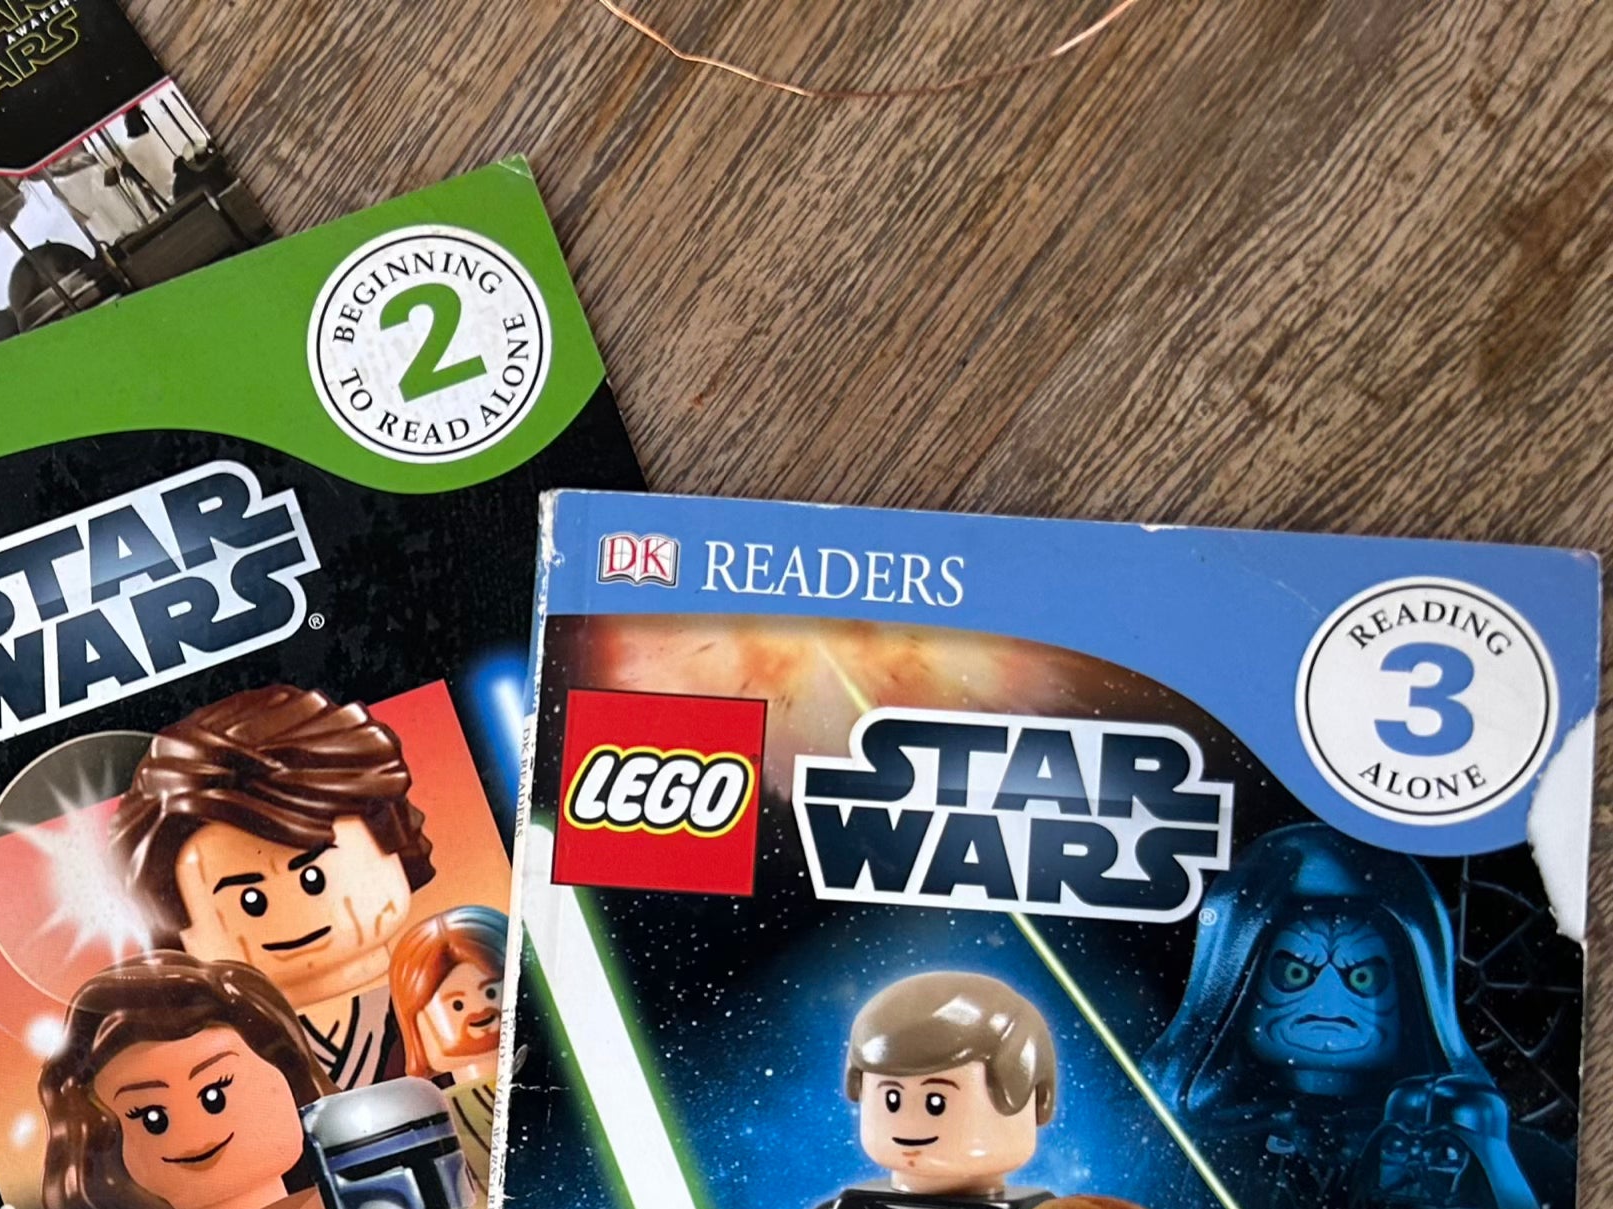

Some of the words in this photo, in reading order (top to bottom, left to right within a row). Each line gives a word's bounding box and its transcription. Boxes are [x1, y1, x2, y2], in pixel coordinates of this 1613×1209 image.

[6, 0, 76, 45] AWAKEN
[333, 251, 503, 344] BEGINNING
[379, 283, 488, 403] 2
[340, 368, 373, 413] TO
[376, 410, 470, 445] READ
[479, 314, 530, 428] ALONE
[607, 538, 668, 576] DK
[702, 540, 965, 608] READERS
[1346, 600, 1512, 657] READING
[1374, 642, 1475, 757] 3
[572, 752, 747, 829] LEGO
[804, 718, 1220, 823] STAR
[1358, 762, 1486, 800] ALONE
[804, 803, 1220, 910] WARS
